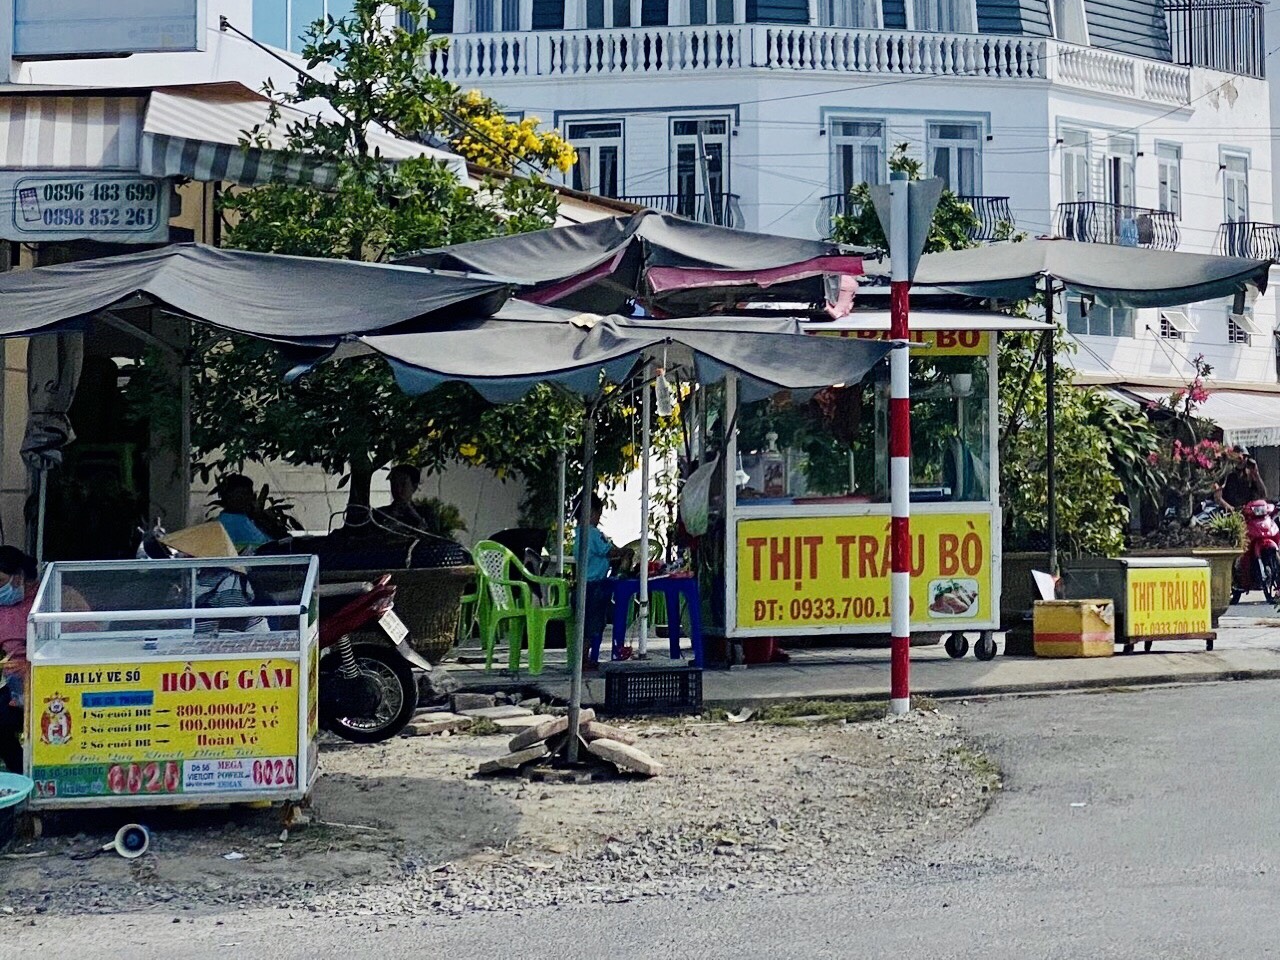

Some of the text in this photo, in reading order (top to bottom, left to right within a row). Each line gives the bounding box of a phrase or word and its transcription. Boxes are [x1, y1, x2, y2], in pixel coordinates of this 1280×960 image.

[43, 183, 156, 201] 0896 483 699
[43, 208, 153, 225] 0898 852 261
[747, 535, 823, 591] THỊT
[939, 521, 983, 576] BÒ
[1132, 572, 1206, 619] THỊT TRÂU BÒ
[754, 599, 783, 620] ĐT:
[81, 742, 87, 750] 2
[217, 760, 243, 770] MEGA
[217, 771, 243, 779] POWER
